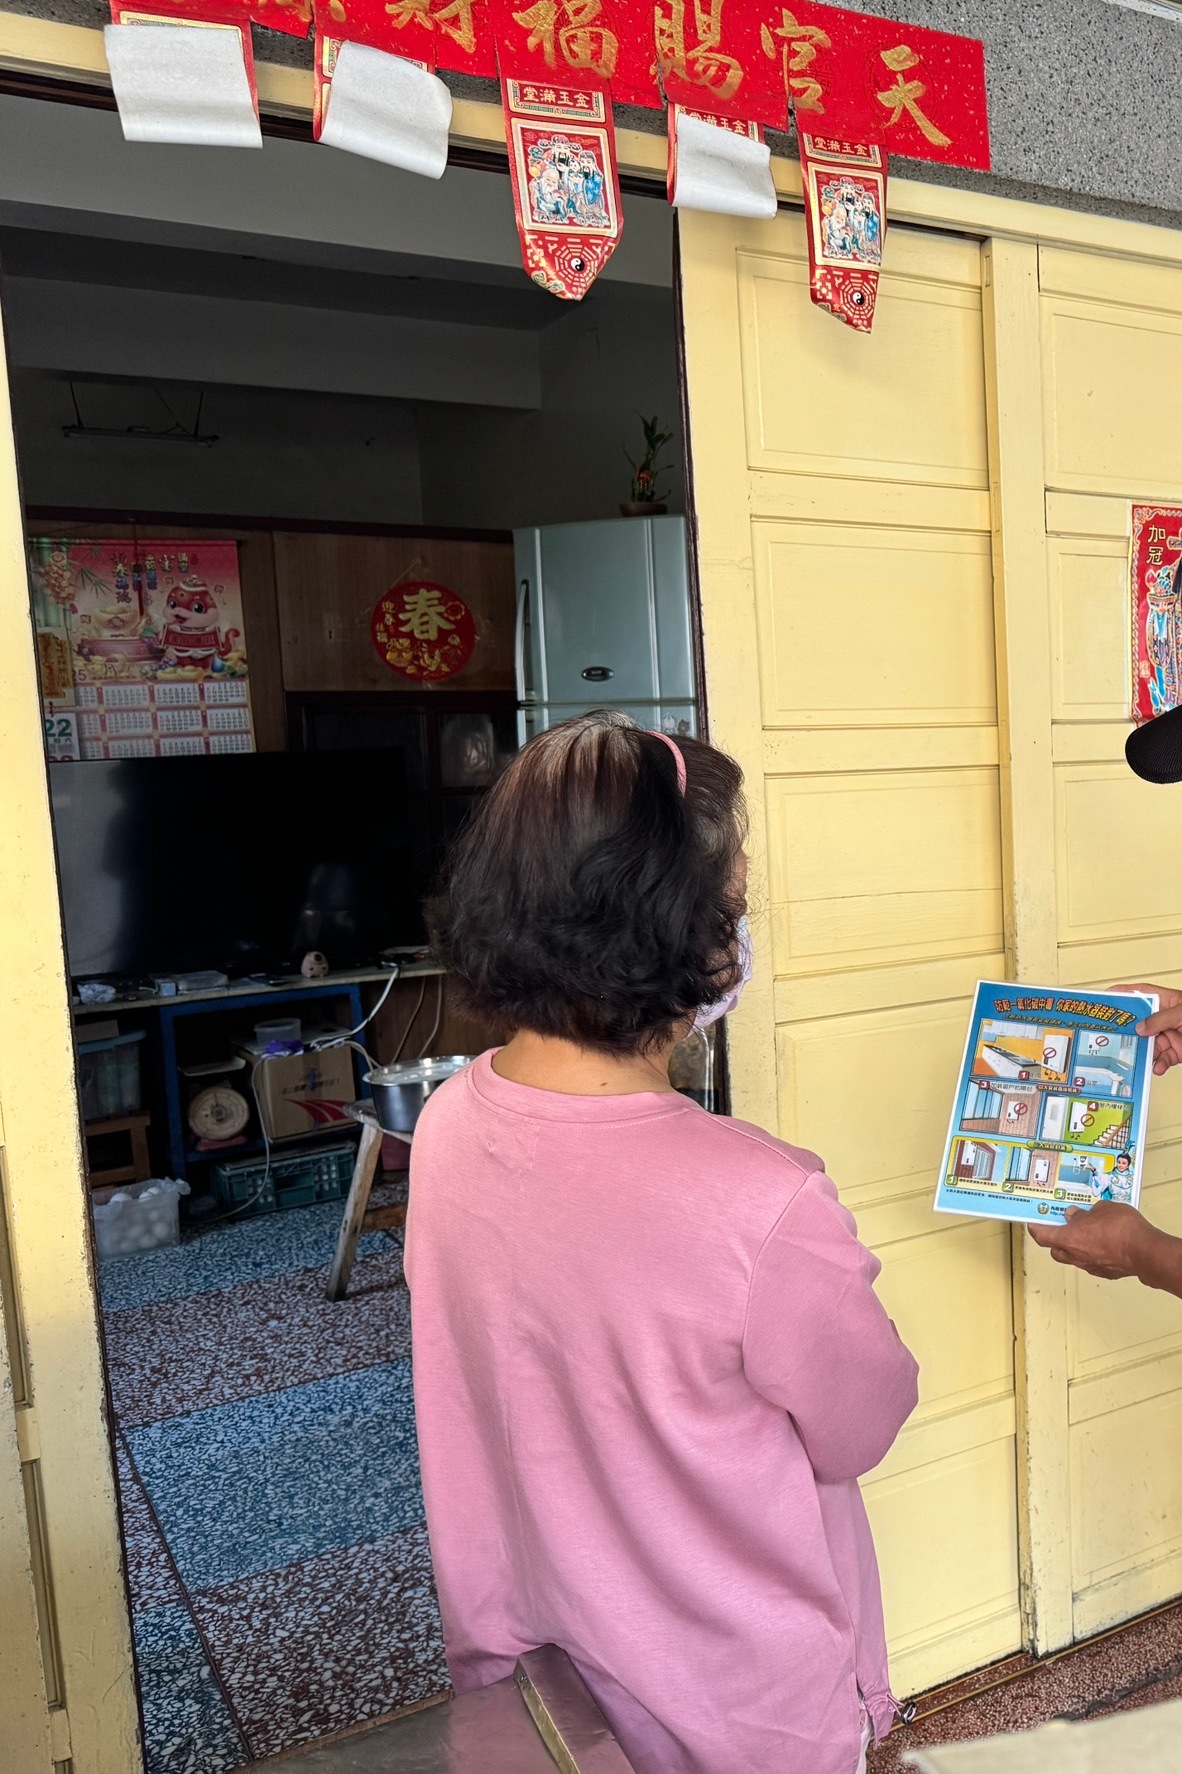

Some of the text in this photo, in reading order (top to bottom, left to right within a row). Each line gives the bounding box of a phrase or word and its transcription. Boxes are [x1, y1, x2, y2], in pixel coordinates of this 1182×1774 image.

[523, 86, 590, 108] 金玉滿堂
[815, 136, 868, 156] 金玉滿堂
[1146, 525, 1166, 566] 加冠
[398, 588, 456, 640] 春
